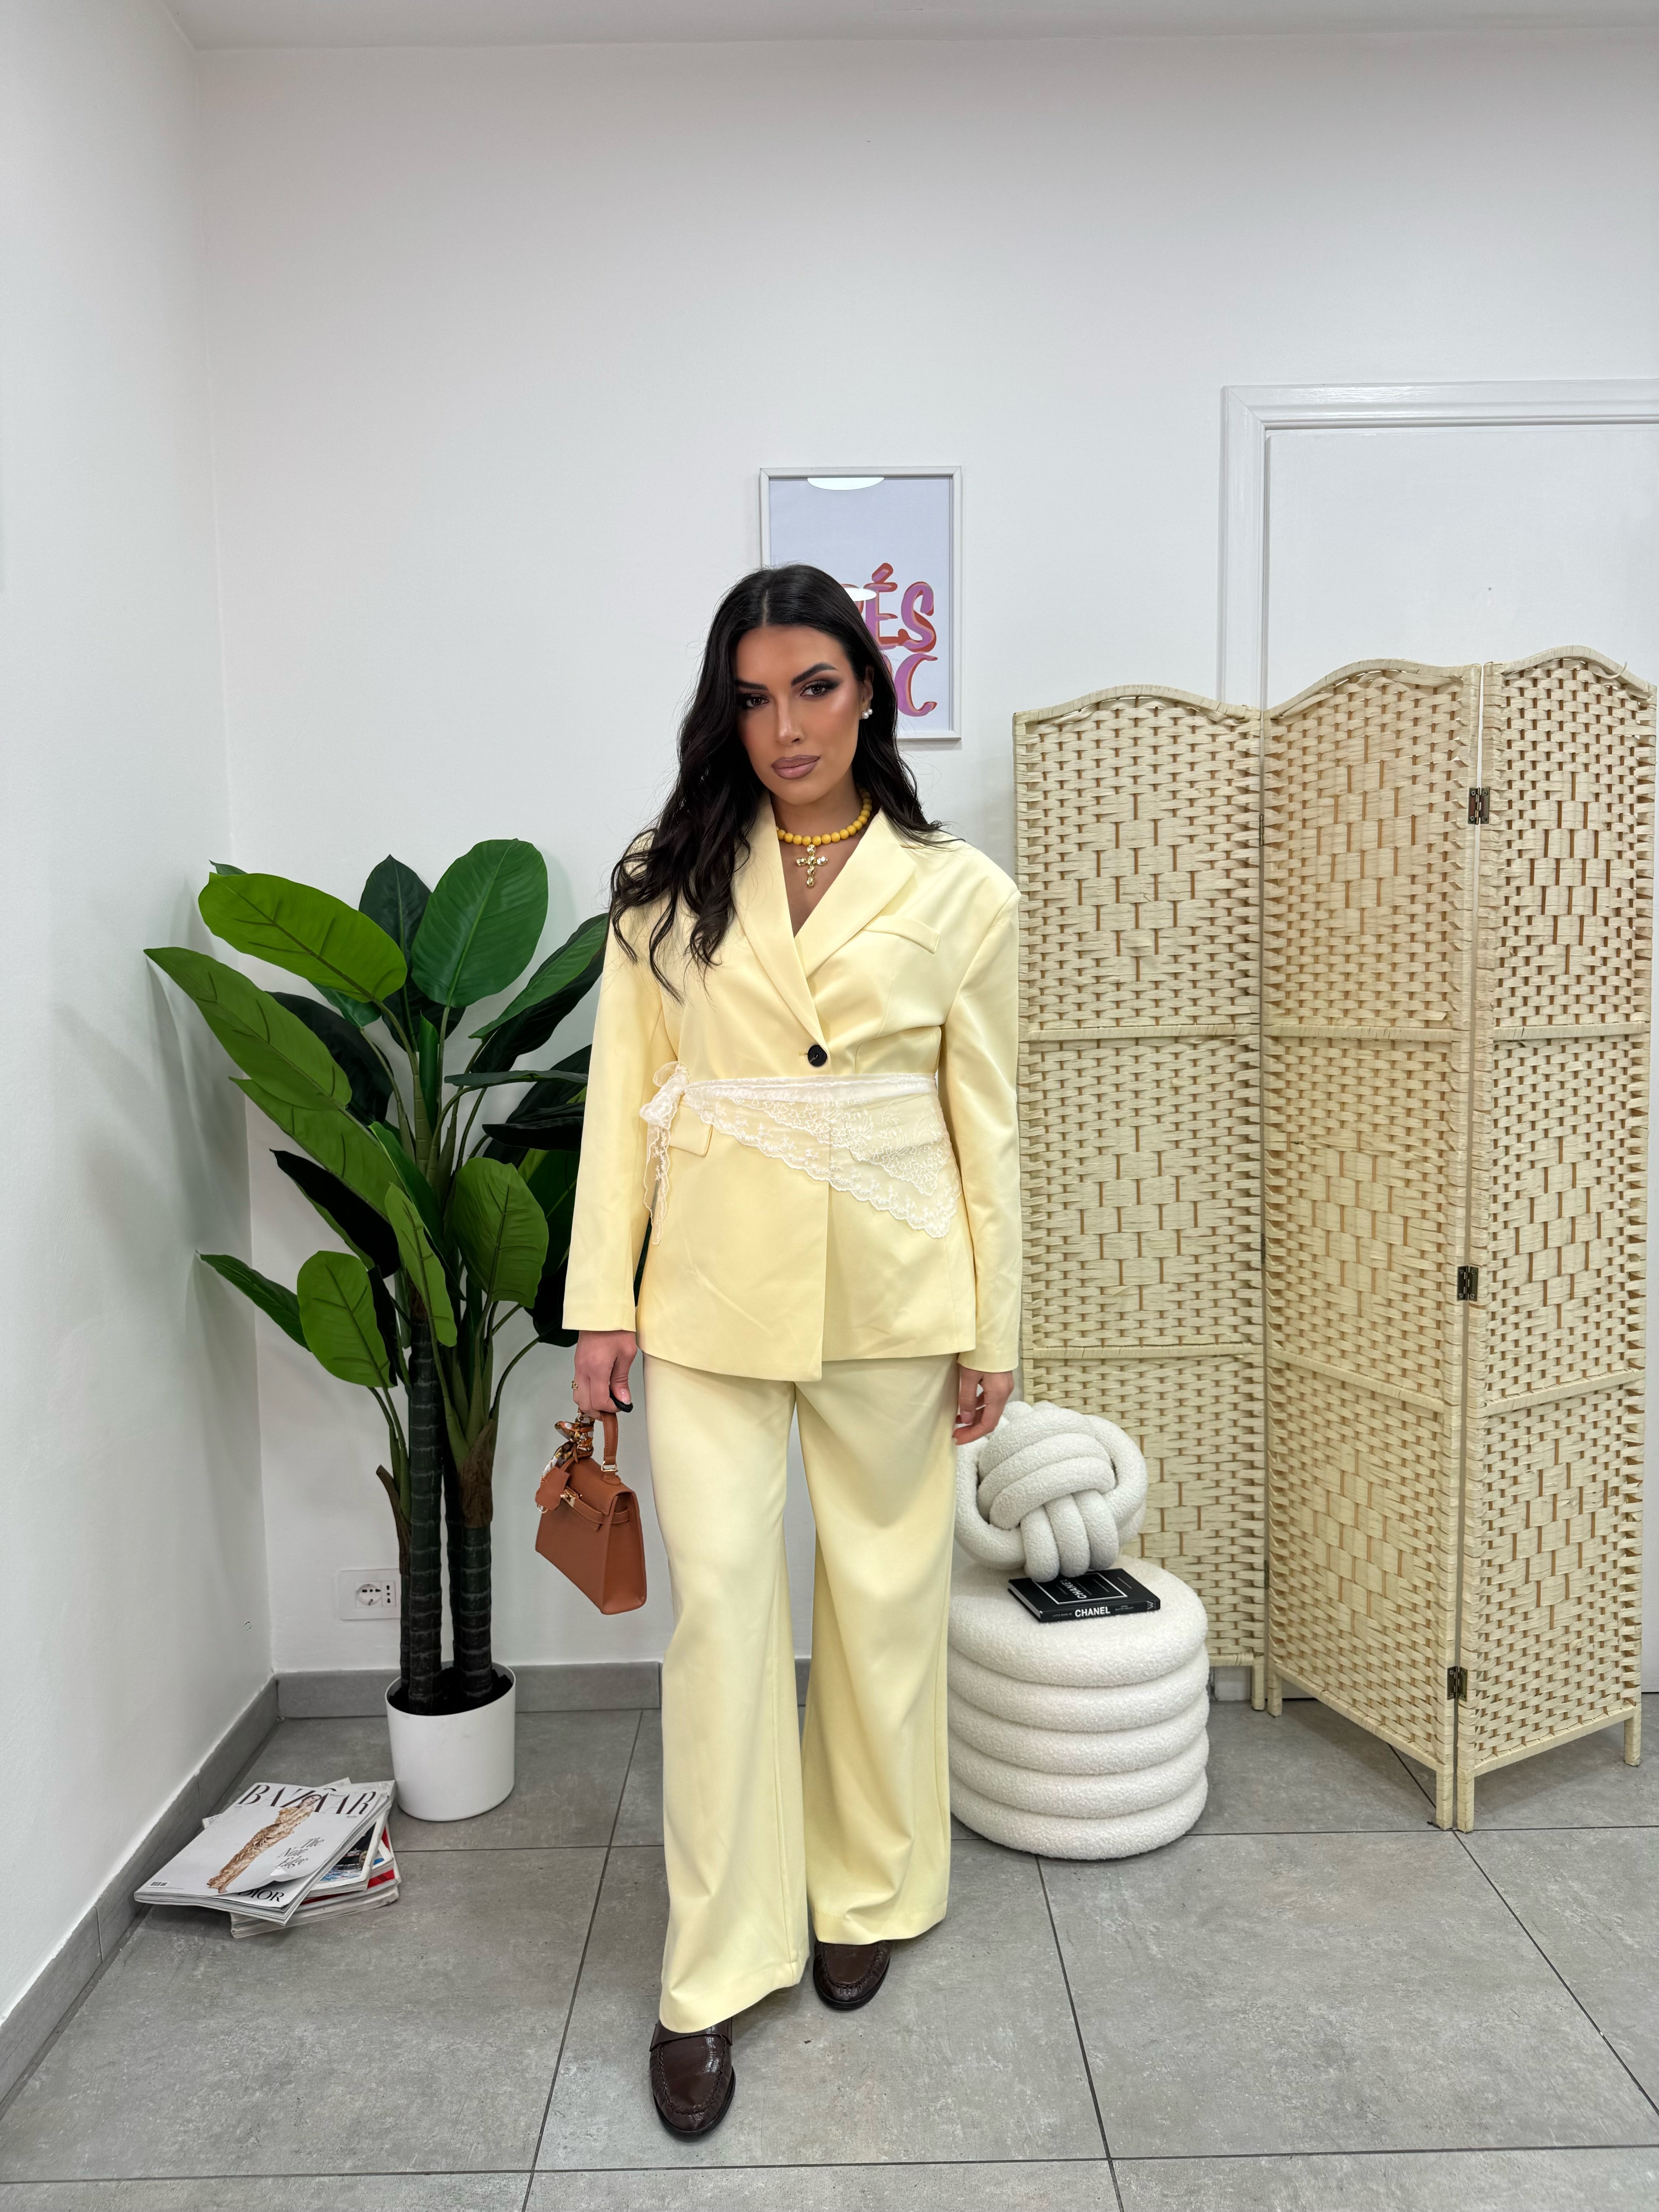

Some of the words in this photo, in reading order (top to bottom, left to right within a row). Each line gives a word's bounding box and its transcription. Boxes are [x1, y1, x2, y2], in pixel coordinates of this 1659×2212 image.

[841, 563, 937, 653] ÉS
[1060, 1580, 1087, 1599] CHANEL
[1075, 1606, 1111, 1617] CHANEL
[238, 1784, 376, 1815] BAZAAR
[301, 1837, 325, 1848] The
